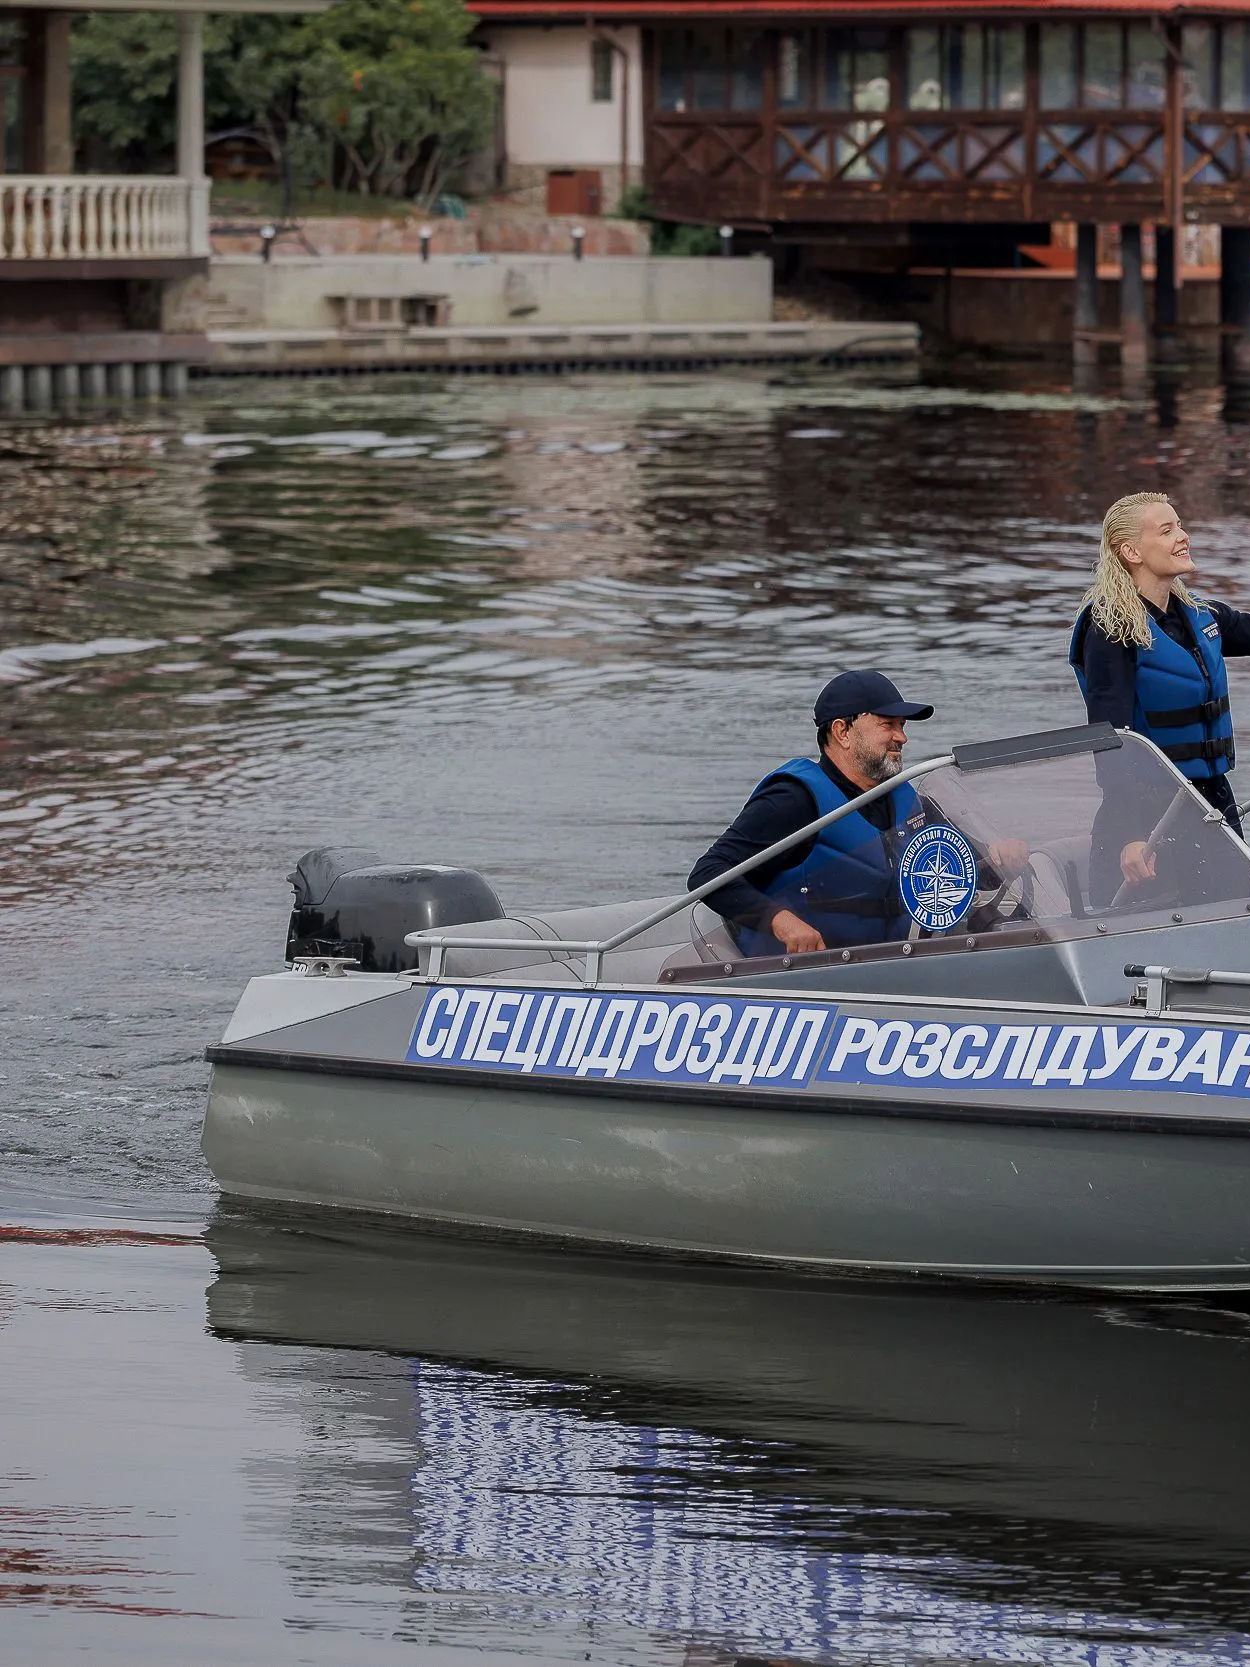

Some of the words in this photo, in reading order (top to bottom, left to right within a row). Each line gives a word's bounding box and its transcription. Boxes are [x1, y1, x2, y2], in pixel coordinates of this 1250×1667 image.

[913, 906, 928, 924] НА
[930, 909, 957, 926] ВОДІ
[415, 987, 830, 1086] СПЕЦПІДРОЗДІЛ
